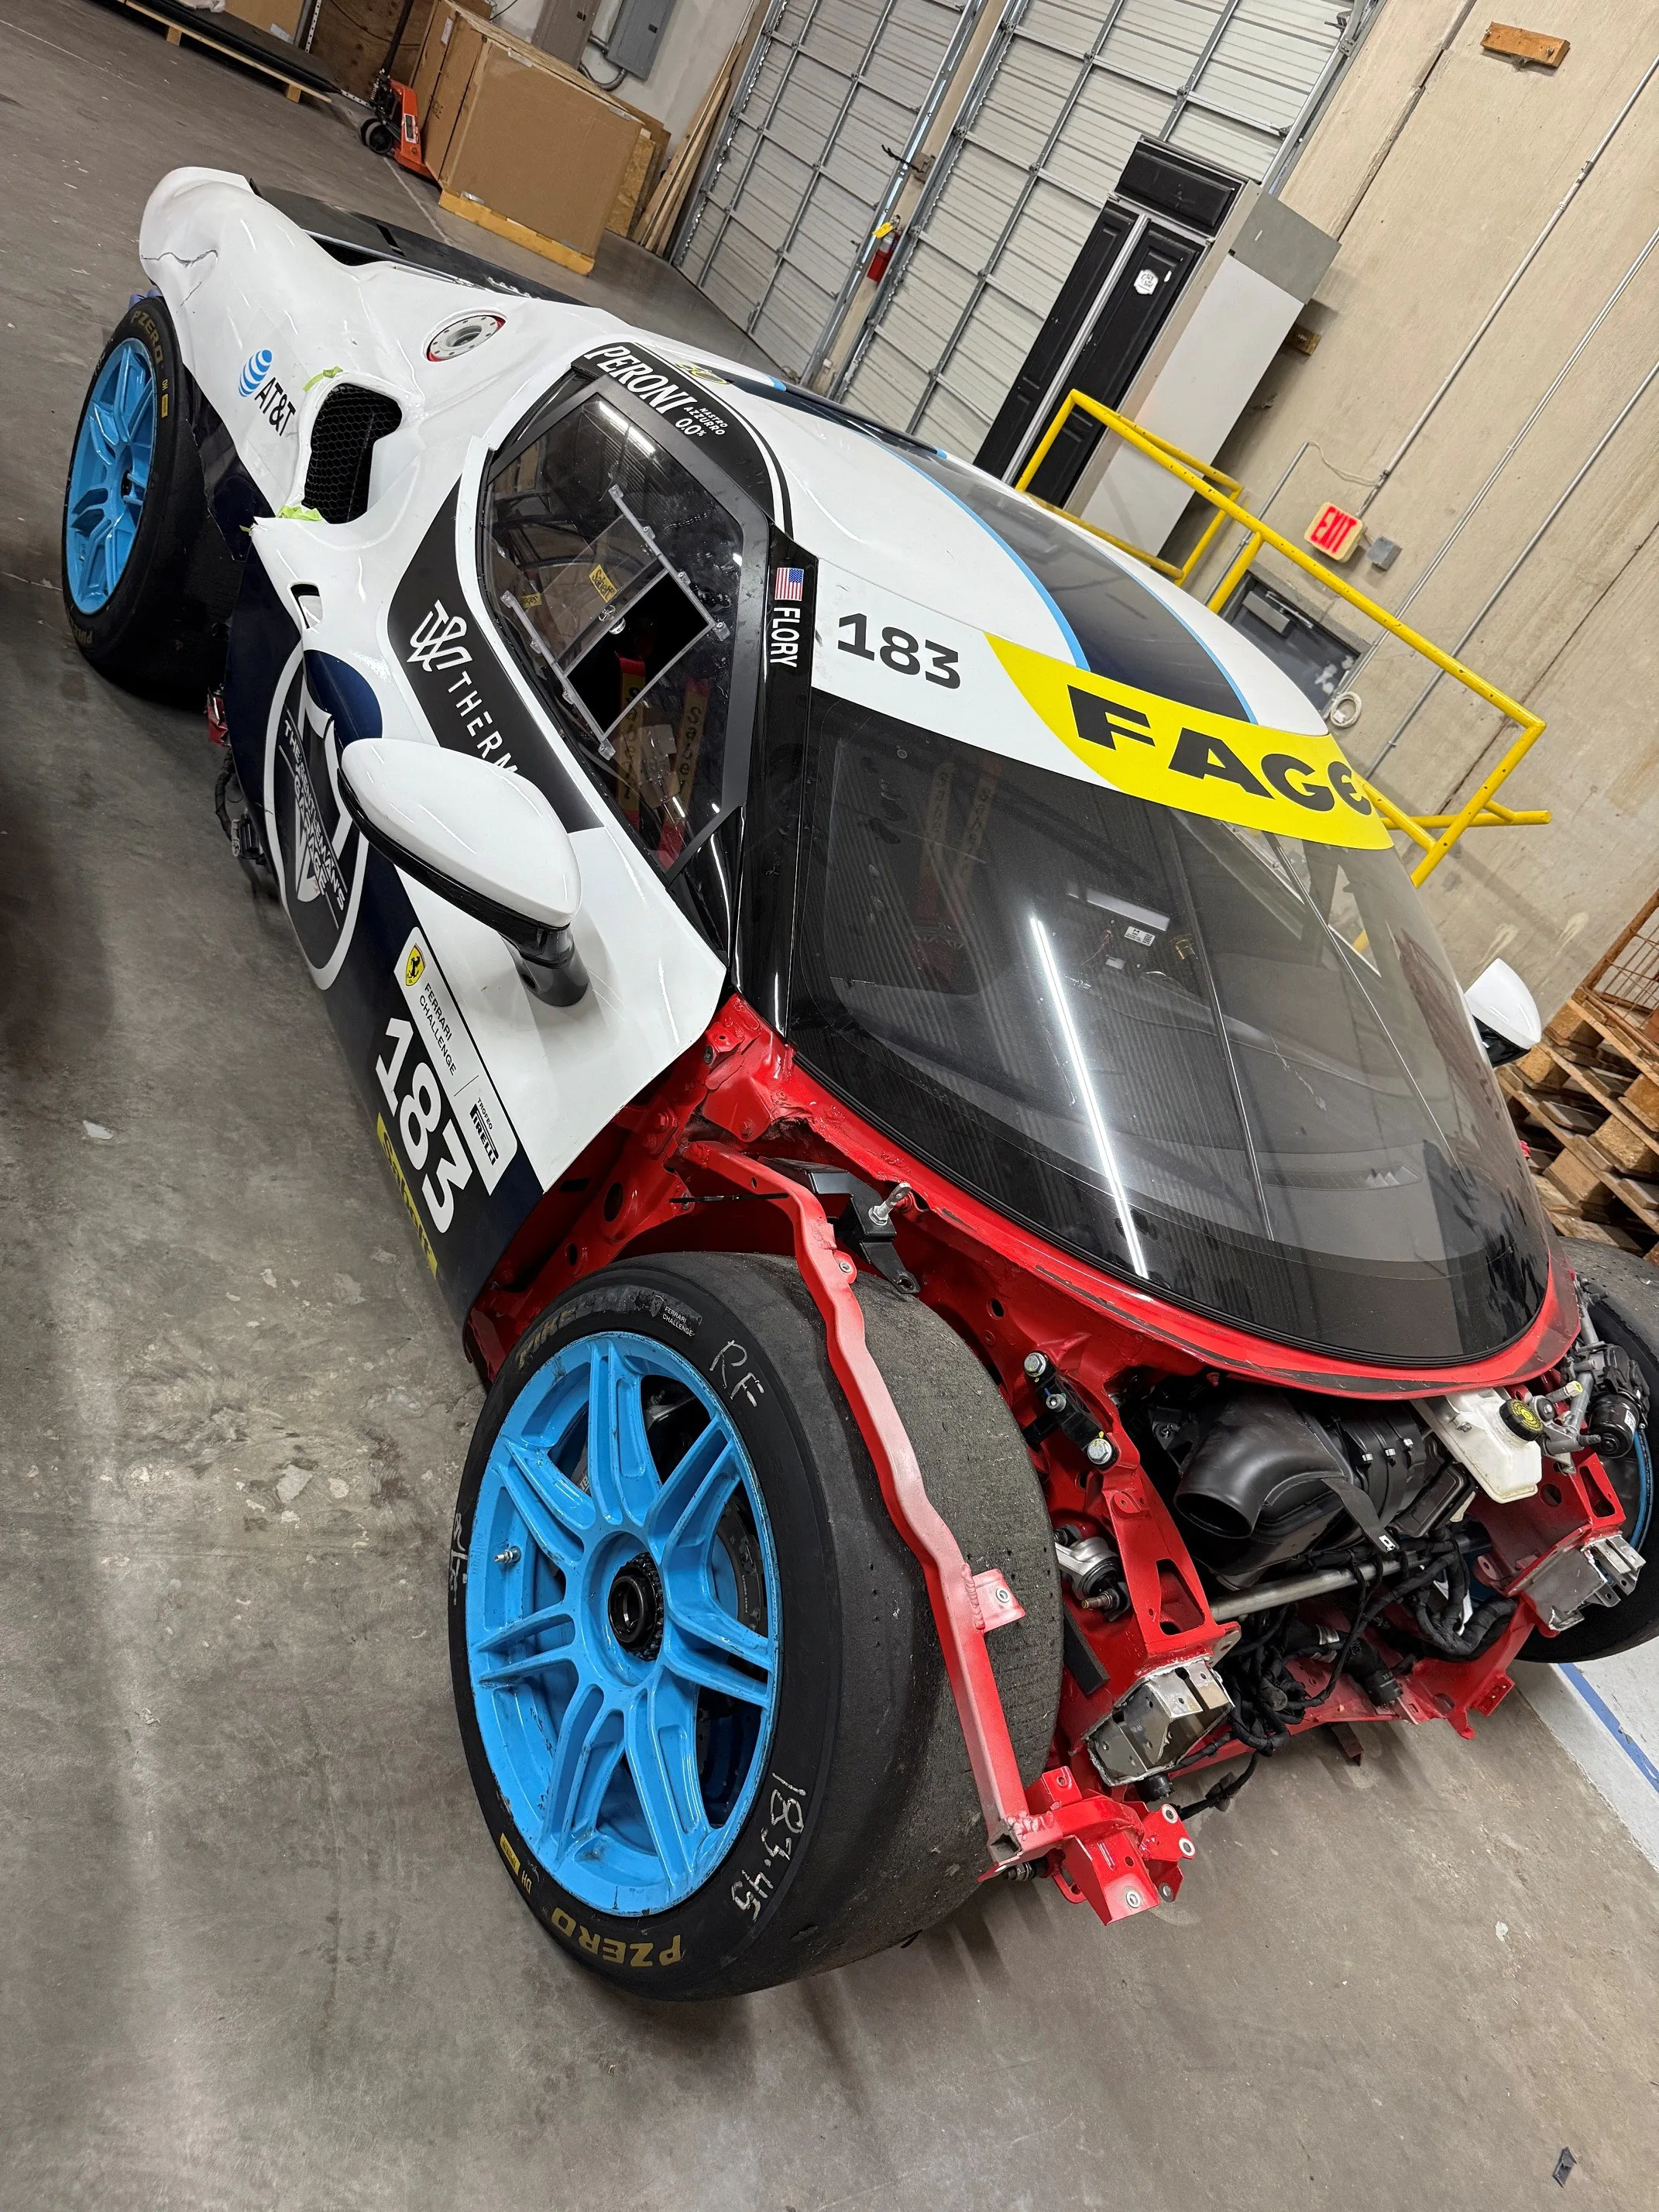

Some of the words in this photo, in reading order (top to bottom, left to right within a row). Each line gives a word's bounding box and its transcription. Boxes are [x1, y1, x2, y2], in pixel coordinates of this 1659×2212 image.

[254, 376, 296, 437] AT&T
[583, 345, 698, 414] PERONI
[675, 418, 706, 437] 0.0%
[684, 407, 725, 435] AZZURRO
[699, 407, 728, 428] NASTRO
[1310, 506, 1357, 554] EXIT
[770, 607, 801, 668] FLORY
[837, 613, 961, 689] 183
[284, 720, 301, 760] THE
[294, 775, 325, 896] GARAGE
[419, 994, 456, 1076] CHALLENGE
[424, 982, 452, 1042] FERRARI
[375, 1017, 473, 1234] 183
[469, 1103, 500, 1166] PIRELLI
[477, 1097, 493, 1130] TROFEO
[662, 1314, 695, 1337] CHALLENGE
[665, 1306, 687, 1324] FERRARI
[709, 1339, 765, 1407] RF
[551, 1907, 682, 1967] PZERO
